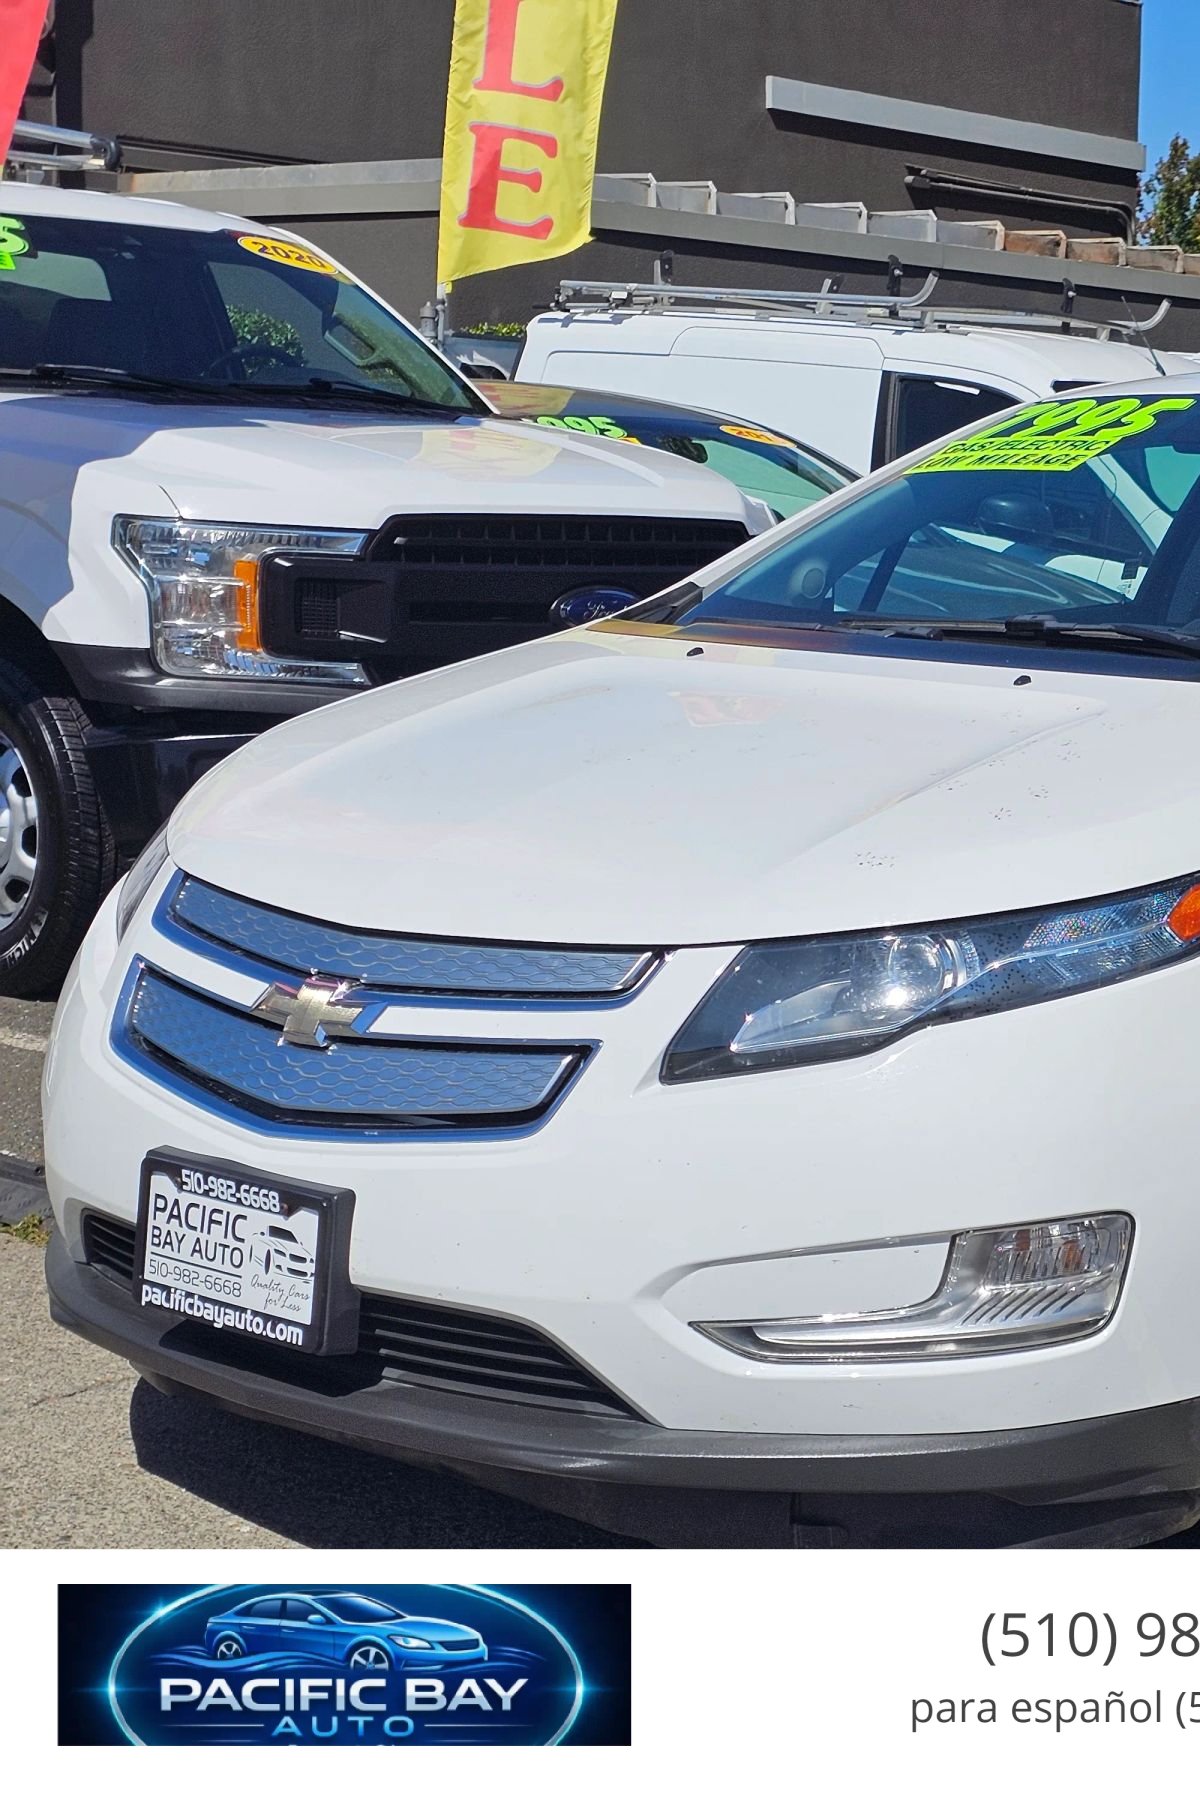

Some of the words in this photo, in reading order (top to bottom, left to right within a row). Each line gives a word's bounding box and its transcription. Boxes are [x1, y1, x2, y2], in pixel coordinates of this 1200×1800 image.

[250, 240, 327, 269] 2020
[964, 453, 1089, 467] MILEAGE
[181, 1168, 281, 1213] 510-982-6668
[153, 1193, 248, 1244] PACIFIC
[150, 1225, 186, 1254] BAY
[190, 1236, 244, 1269] AUTO
[149, 1259, 242, 1298] 510-982-6668
[250, 1273, 285, 1299] Quality
[288, 1283, 311, 1301] Cars
[141, 1284, 303, 1345] pacificbayauto.com
